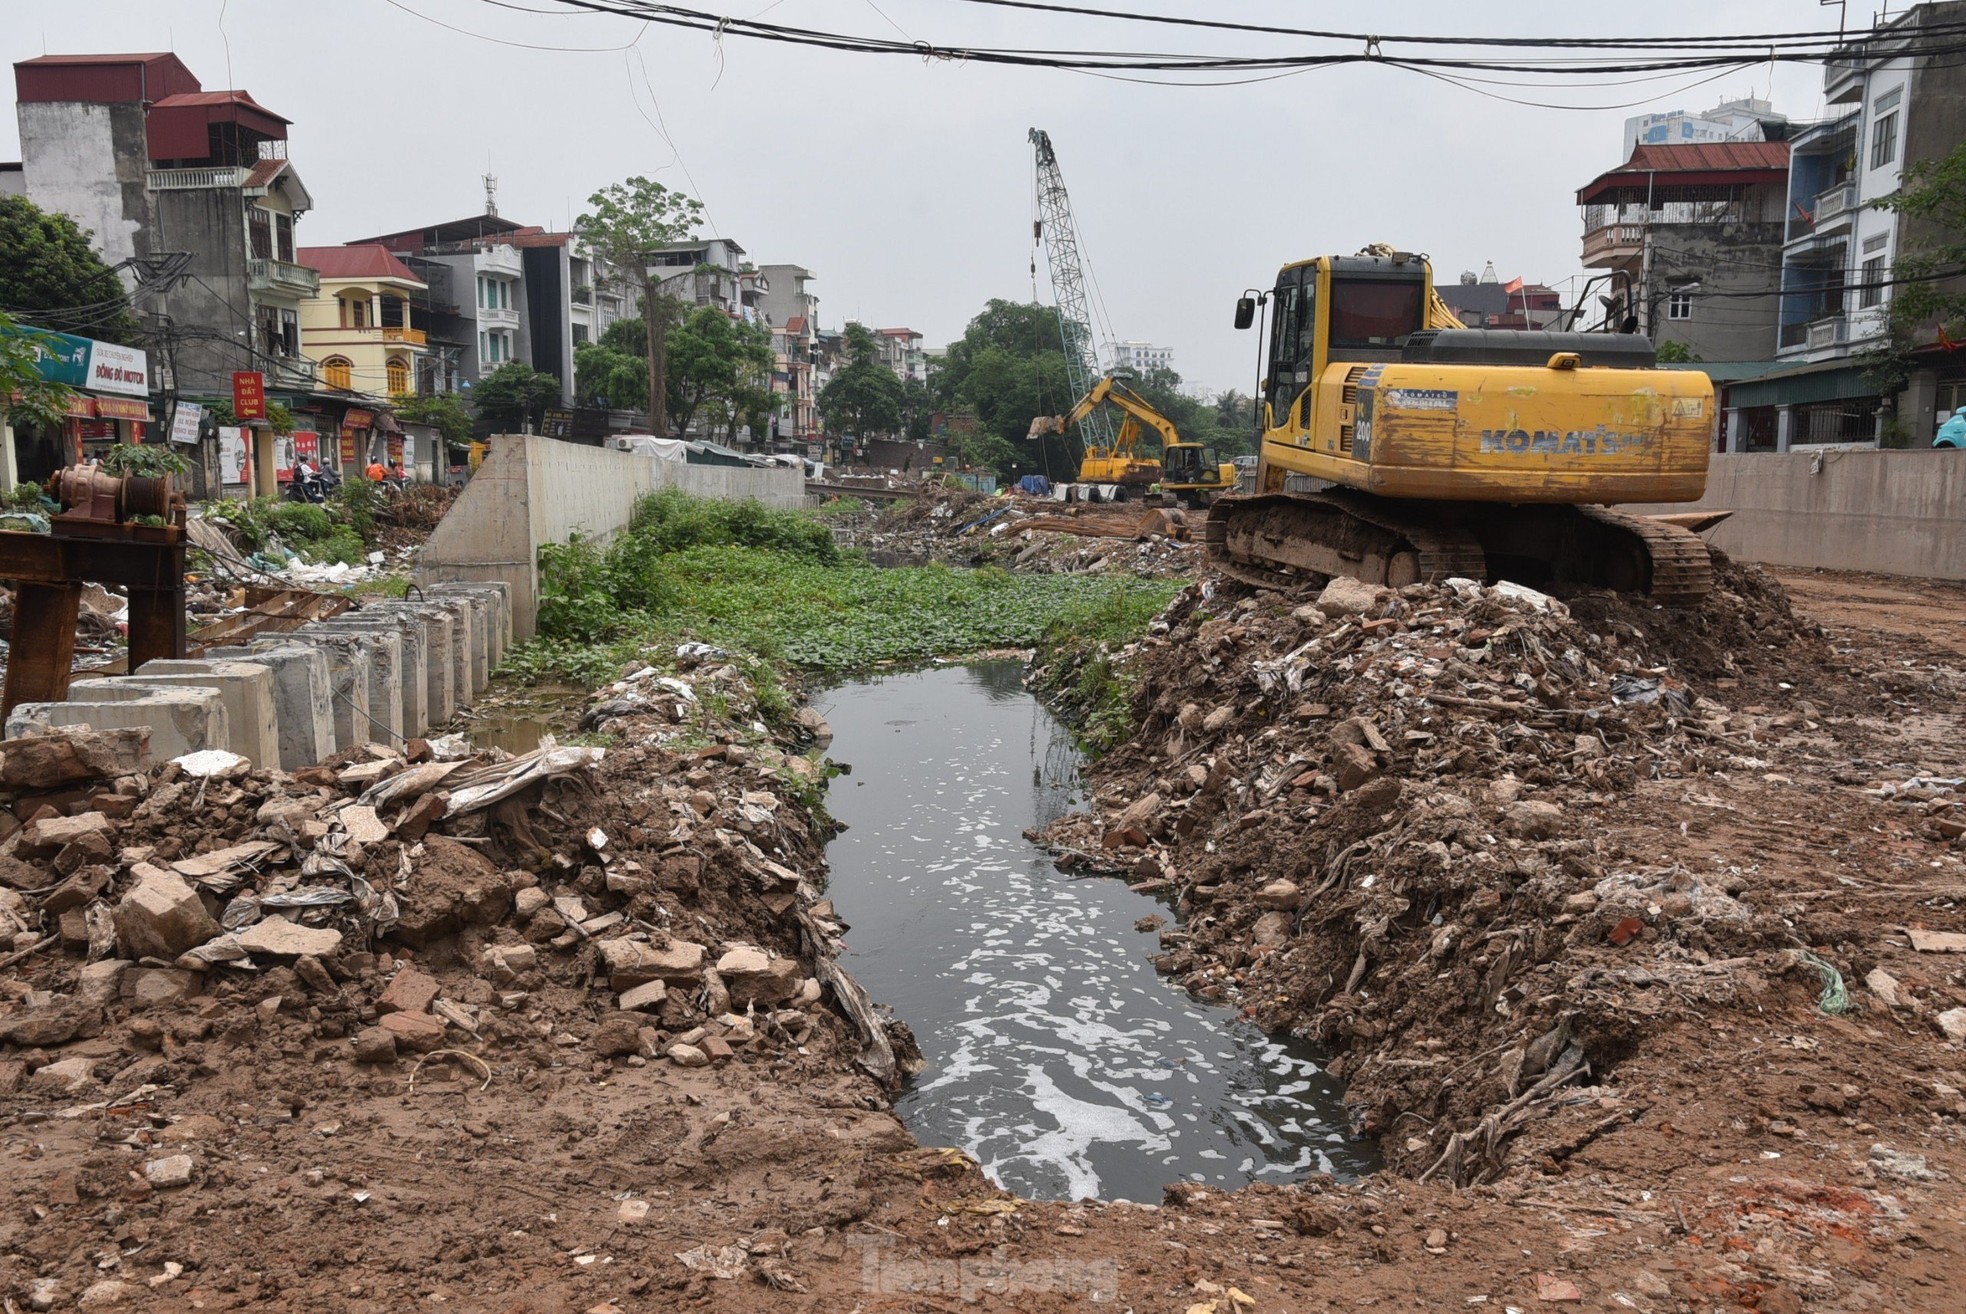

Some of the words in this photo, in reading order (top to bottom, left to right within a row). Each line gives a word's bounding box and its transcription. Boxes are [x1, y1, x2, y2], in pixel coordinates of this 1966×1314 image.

[123, 369, 145, 386] MOTOR
[239, 377, 255, 385] NHÀ
[241, 387, 256, 395] ĐẤT
[240, 398, 259, 406] CLUB
[1356, 420, 1371, 442] 200
